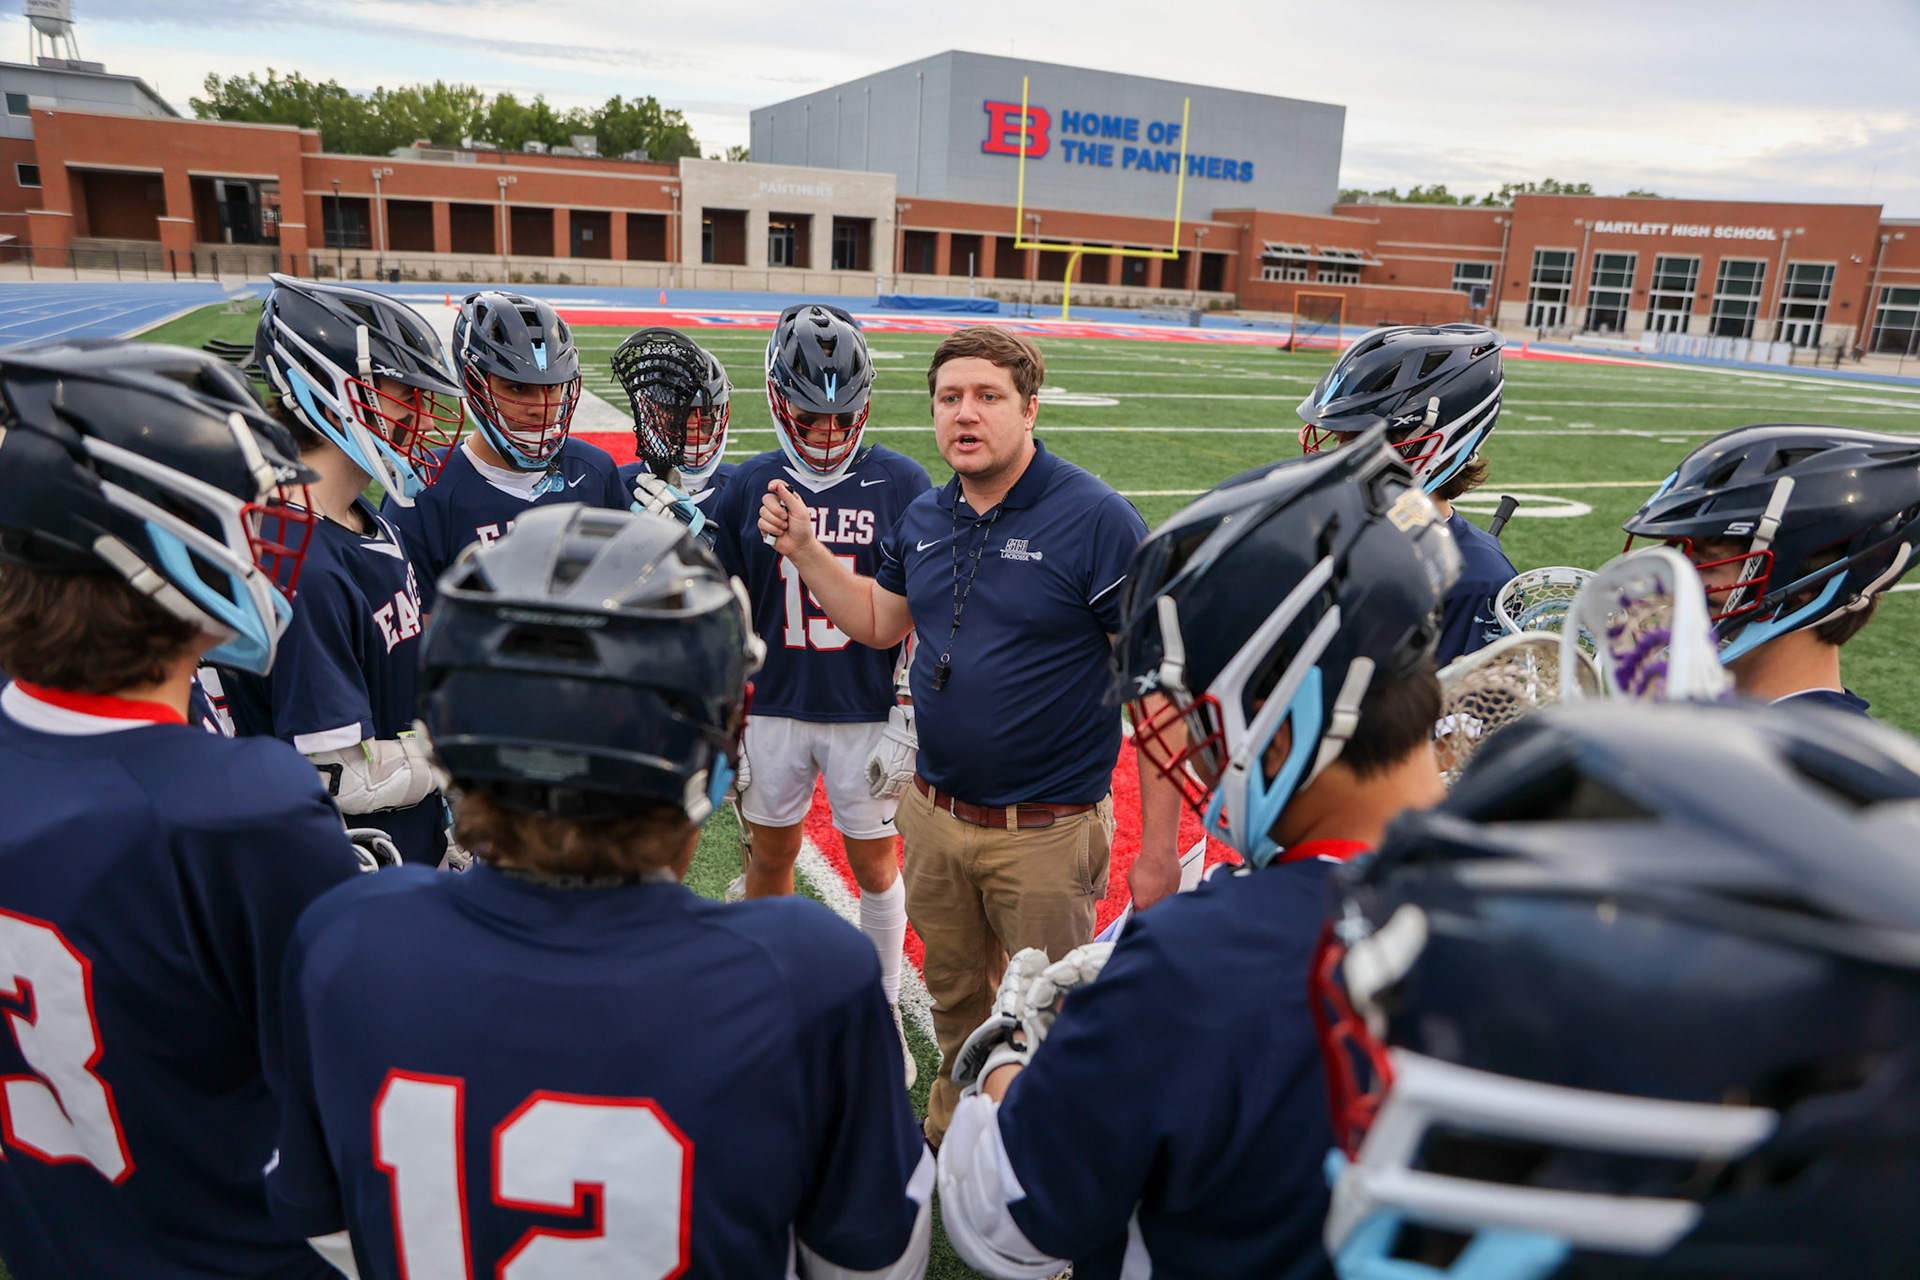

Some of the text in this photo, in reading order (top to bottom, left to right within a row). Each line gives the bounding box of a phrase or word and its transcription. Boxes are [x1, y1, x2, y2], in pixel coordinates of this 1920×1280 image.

[982, 100, 1050, 160] B
[1061, 110, 1181, 146] HOME OF
[1060, 140, 1254, 182] THE PANTHERS
[759, 182, 833, 198] PANTHERS
[1594, 220, 1777, 241] BARTLETT HIGH SCHOOL
[1000, 551, 1030, 562] LACROSSE
